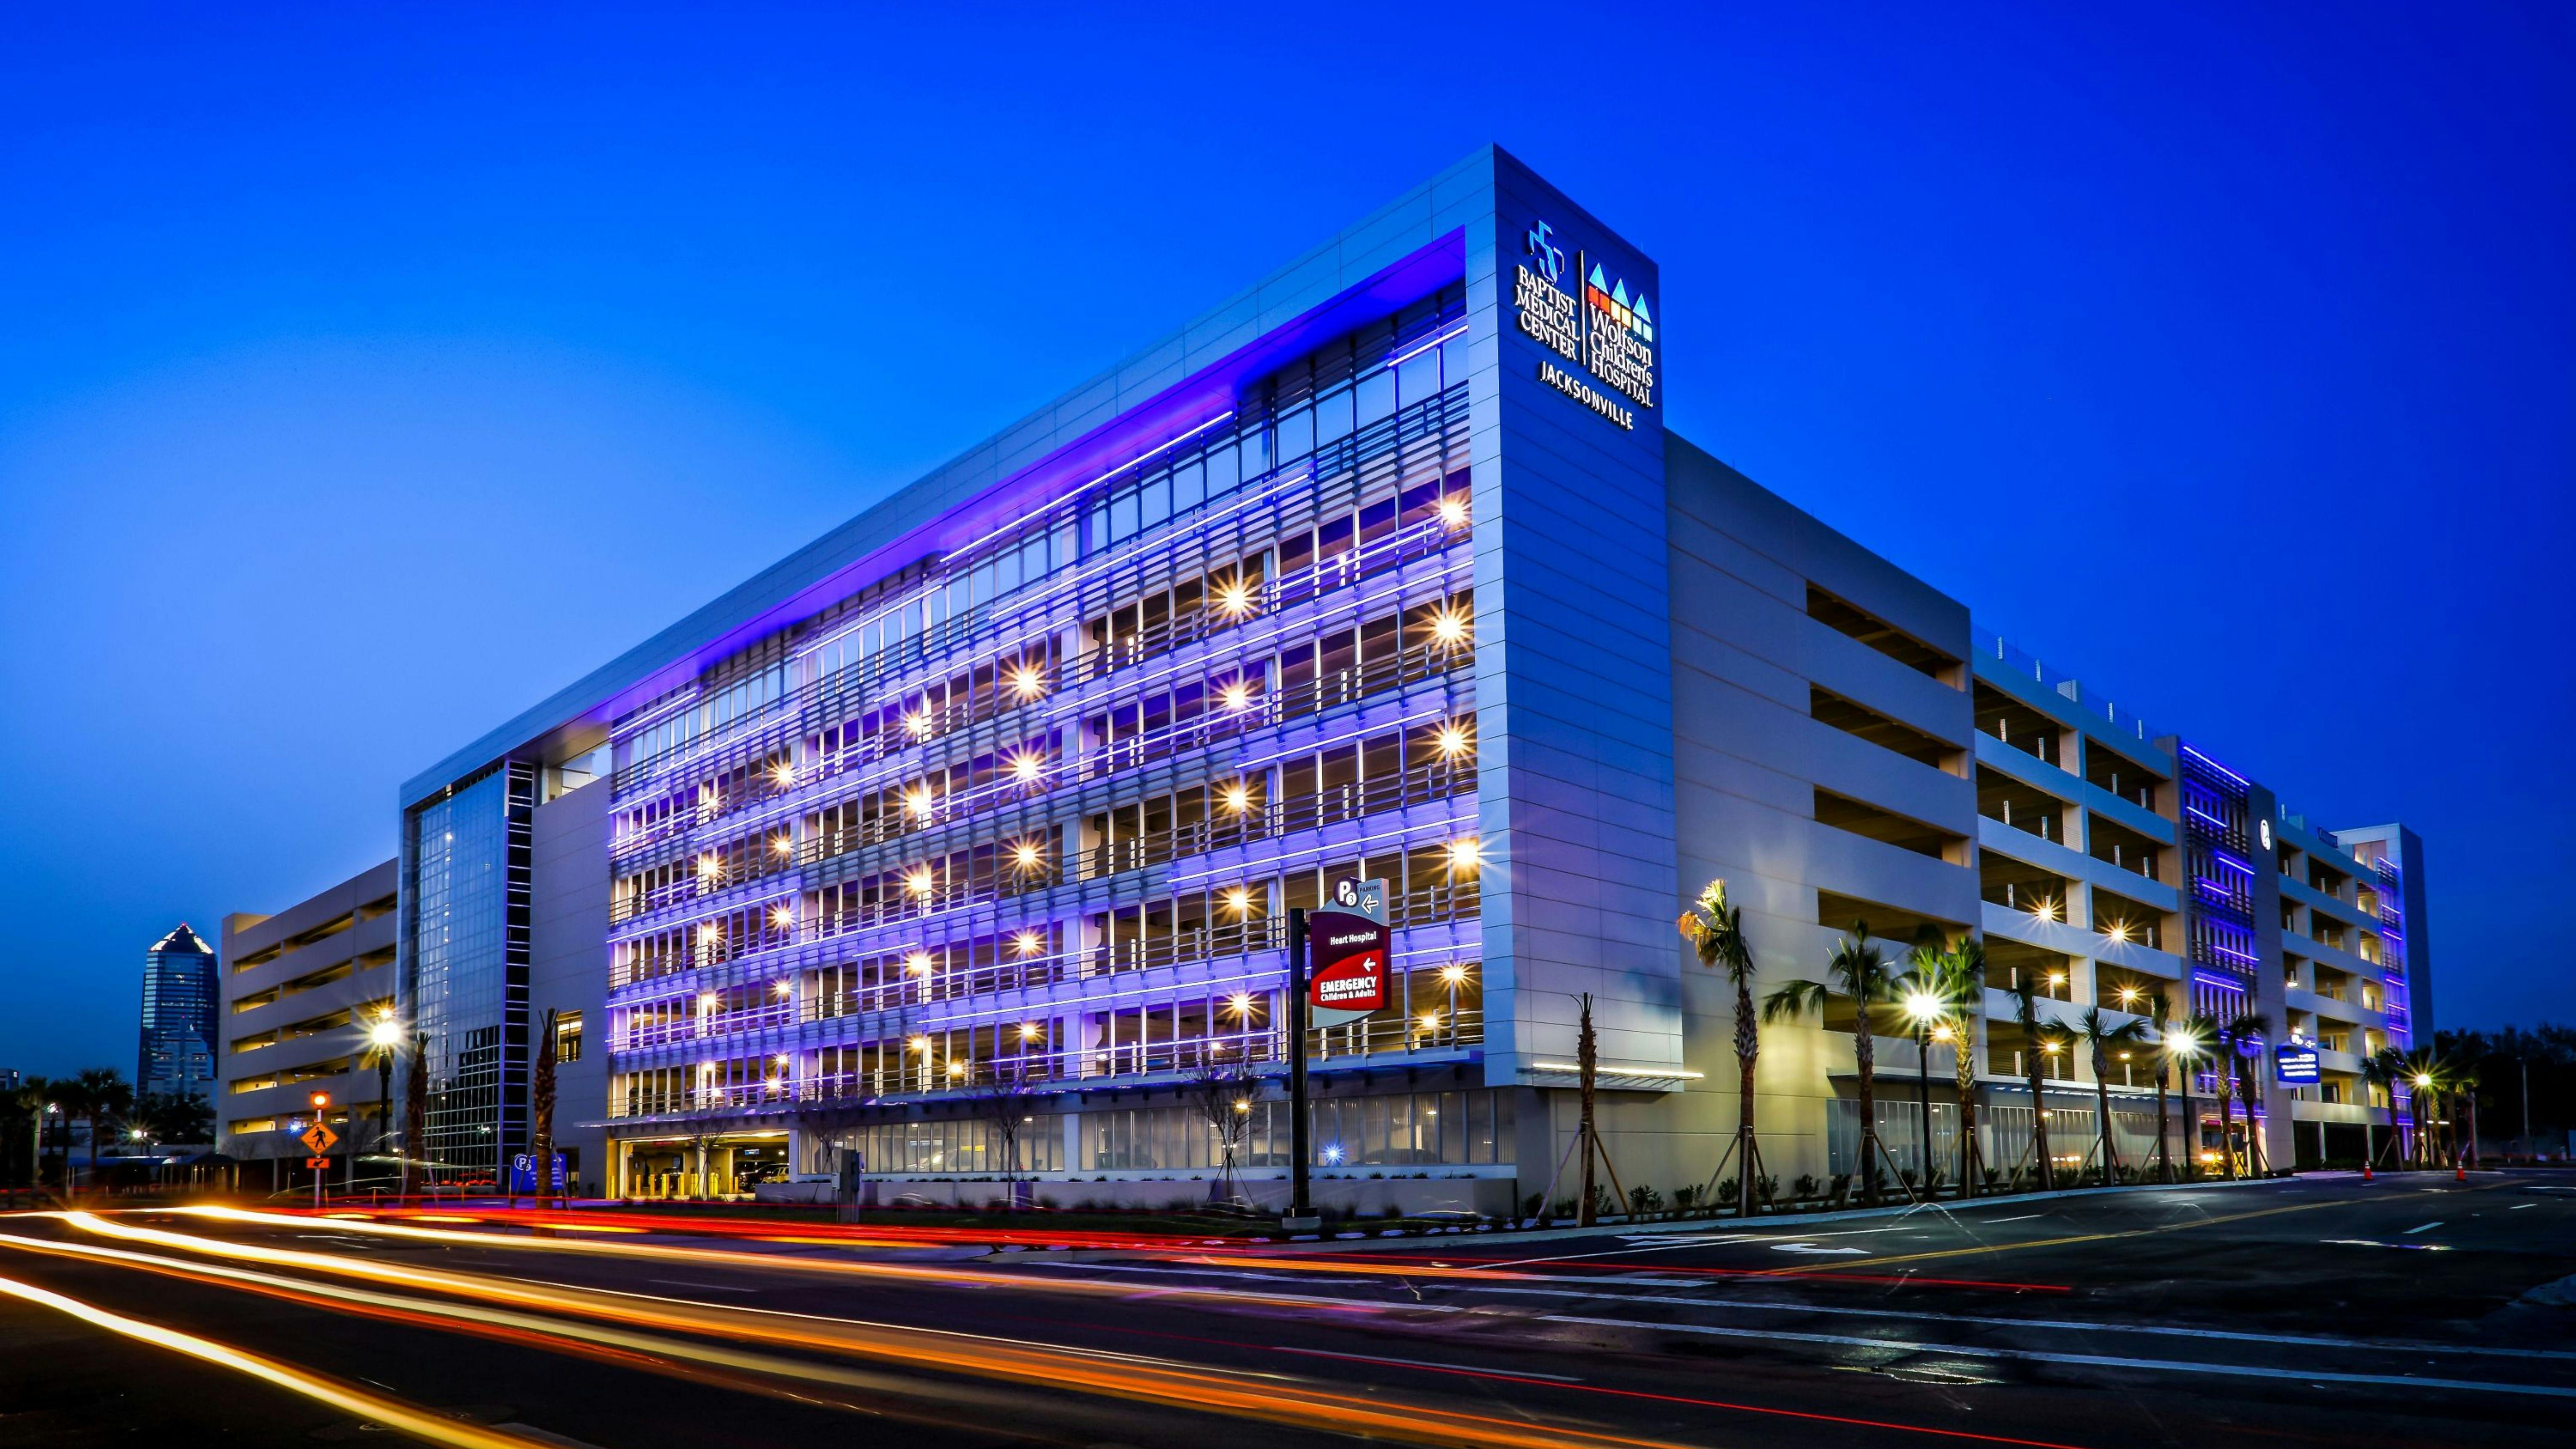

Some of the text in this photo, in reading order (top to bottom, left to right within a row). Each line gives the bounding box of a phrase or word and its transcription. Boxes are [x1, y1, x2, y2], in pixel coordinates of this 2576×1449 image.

[1515, 284, 1580, 341] MEDICAL
[1518, 264, 1576, 316] BAPTIST
[1521, 311, 1577, 361] CENTER
[1590, 302, 1652, 367] Wolfson
[1590, 331, 1653, 387] Children's
[1540, 361, 1633, 430] JACKSONVILLE
[1591, 350, 1653, 408] HOSPITAL
[1360, 885, 1380, 893] PARKING
[1330, 931, 1376, 945] Heart Hospital
[1321, 976, 1377, 993] EMERGENCY
[1321, 992, 1348, 1001] Children
[1355, 989, 1376, 998] Adults
